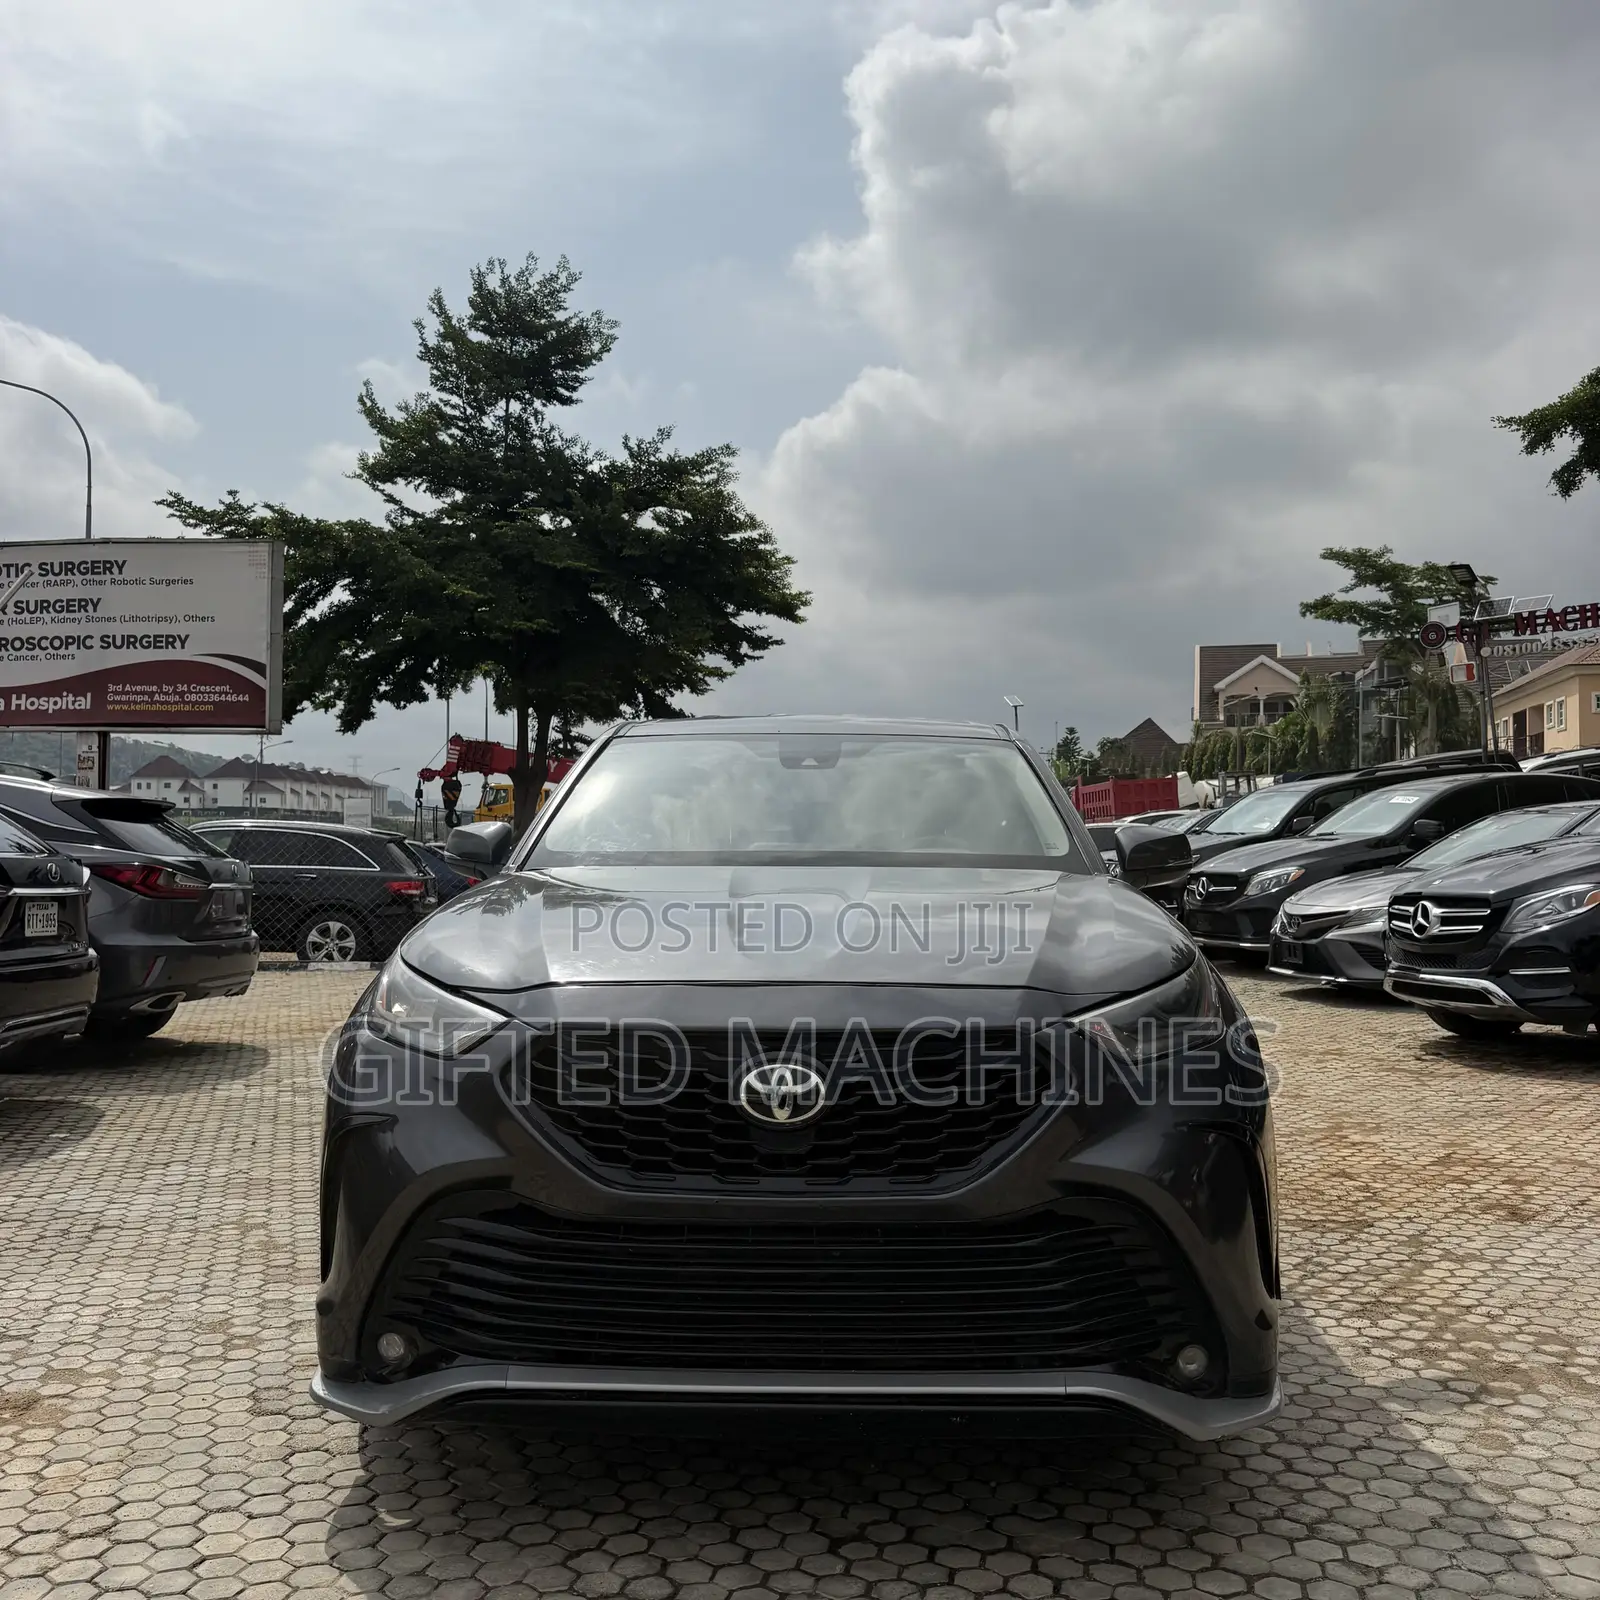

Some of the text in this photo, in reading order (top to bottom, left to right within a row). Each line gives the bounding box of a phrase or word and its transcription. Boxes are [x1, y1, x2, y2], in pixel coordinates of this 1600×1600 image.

[38, 560, 128, 577] SURGERY
[42, 578, 79, 589] (RARP),
[81, 577, 108, 587] Other
[110, 577, 147, 586] Robotic
[149, 577, 194, 587] Surgeries
[13, 598, 102, 615] SURGERY
[8, 616, 48, 626] (HoLEP),
[50, 615, 82, 625] Kidney
[85, 614, 117, 624] Stones
[119, 613, 181, 625] (Lithotripsy),
[183, 613, 216, 623] Others
[99, 633, 190, 650] SURGERY
[7, 653, 42, 662] Cancer,
[44, 652, 76, 661] Others
[107, 683, 233, 693] 3rd Avenue, by 34 Crescent,
[11, 691, 92, 713] Hospital
[107, 693, 151, 703] Gwarinpa,
[184, 694, 250, 702] 08033644644
[106, 702, 214, 712] www.kelinahospital.com
